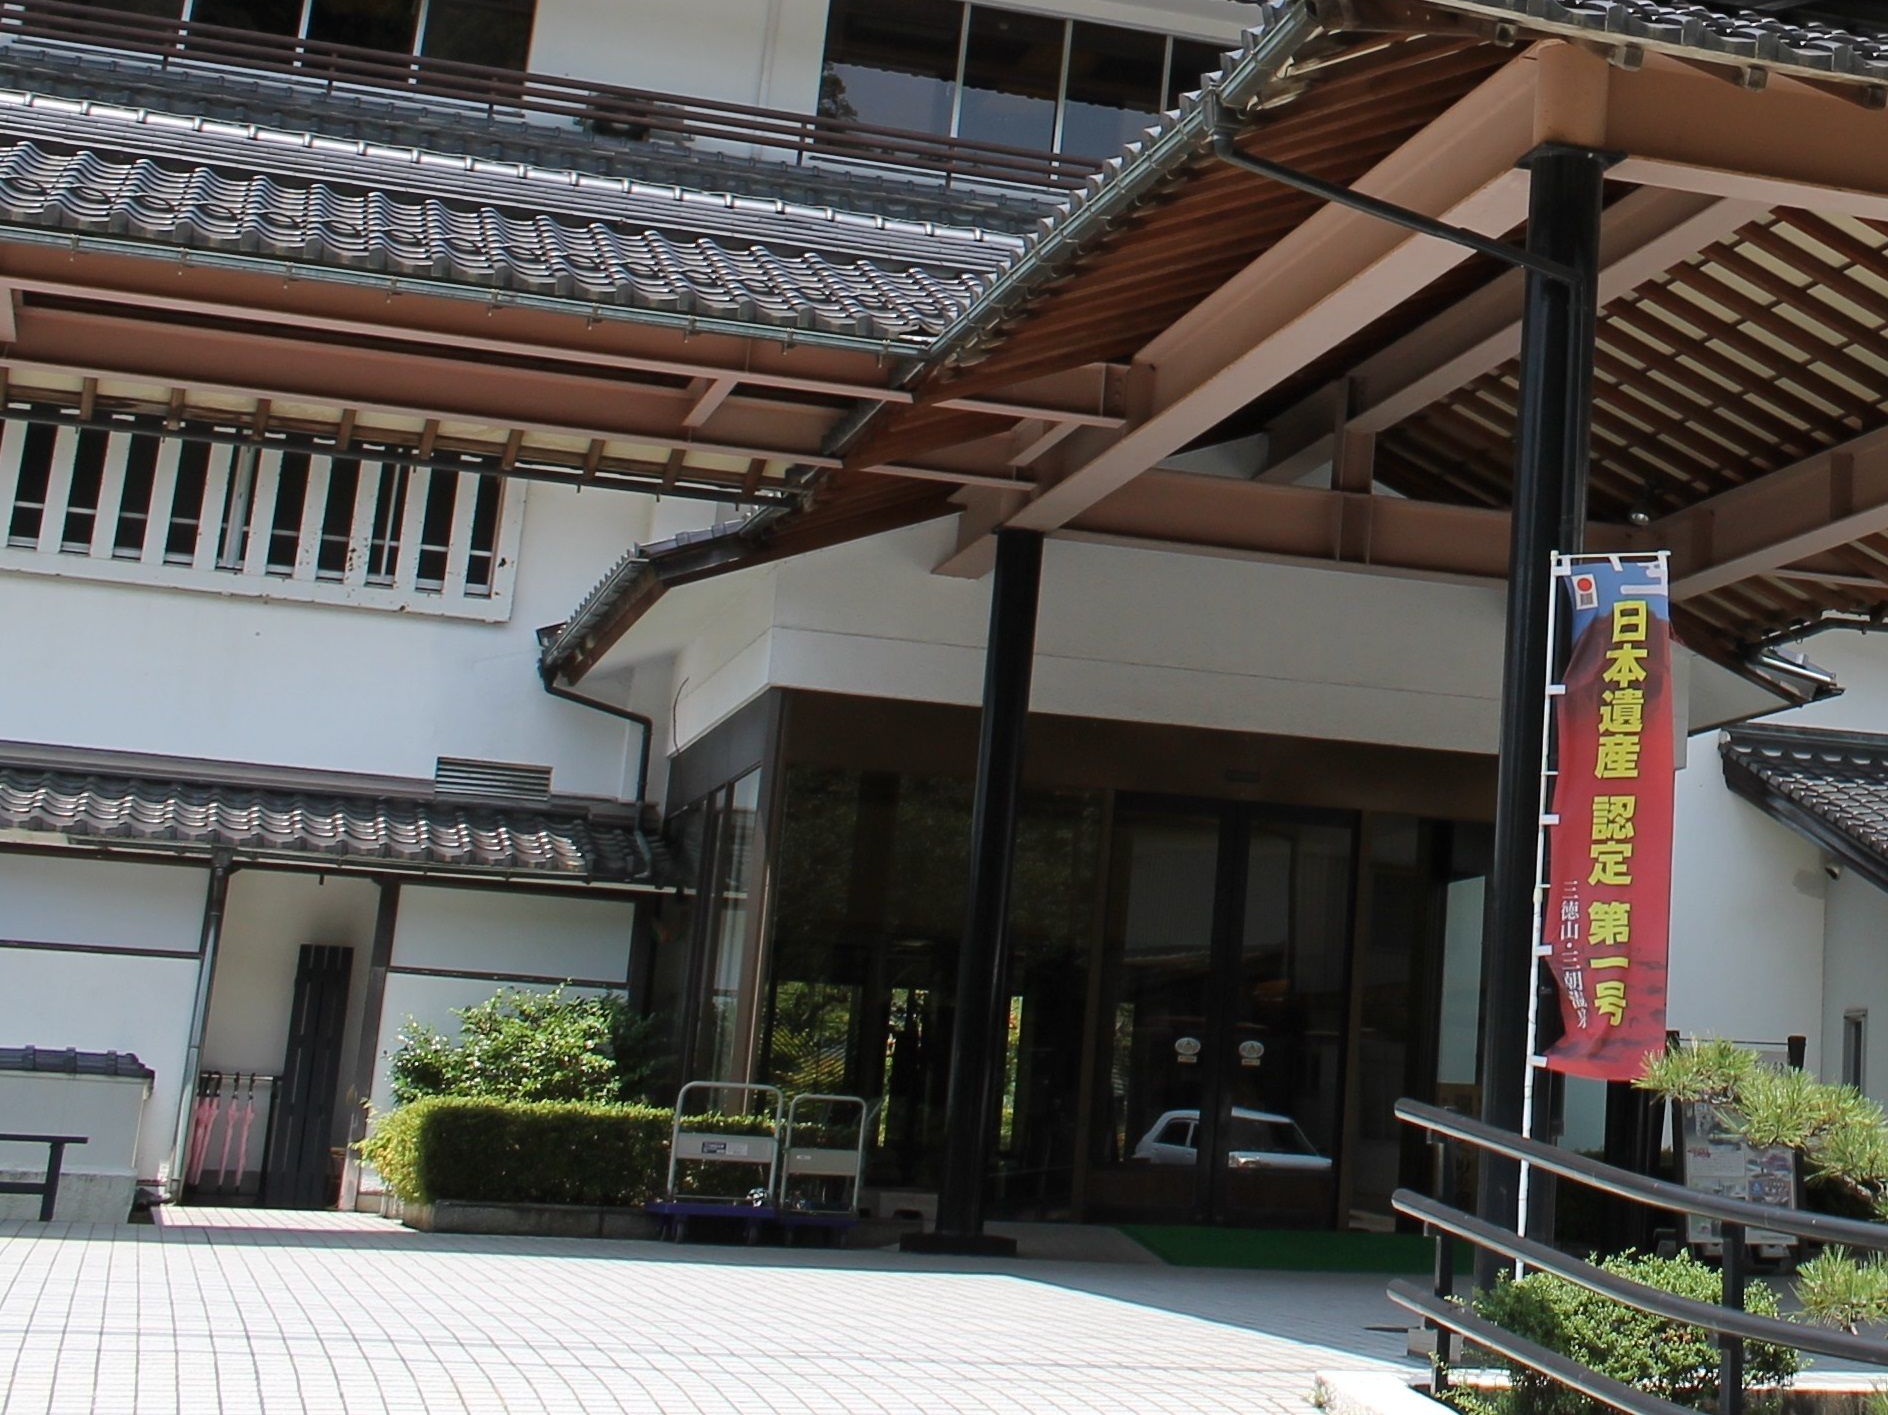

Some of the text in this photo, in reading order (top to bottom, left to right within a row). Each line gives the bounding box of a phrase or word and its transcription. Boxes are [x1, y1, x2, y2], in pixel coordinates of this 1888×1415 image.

[1588, 600, 1648, 1026] 日本遺産 認定 第一号
